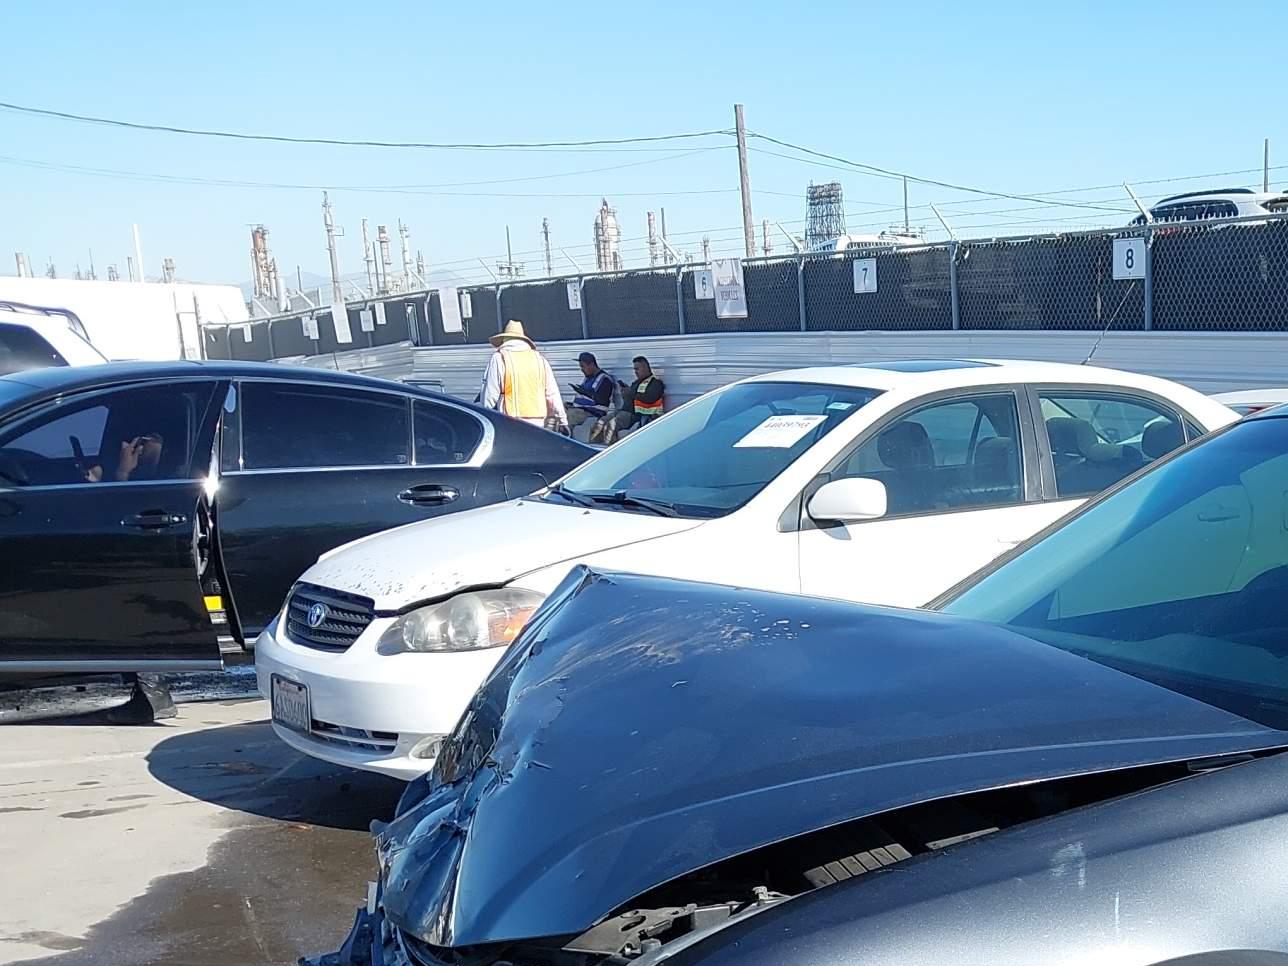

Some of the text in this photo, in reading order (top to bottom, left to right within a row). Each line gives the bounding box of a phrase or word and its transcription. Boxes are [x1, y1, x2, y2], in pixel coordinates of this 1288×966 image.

[1125, 248, 1134, 269] 8
[701, 276, 707, 292] 6
[861, 267, 868, 286] 7
